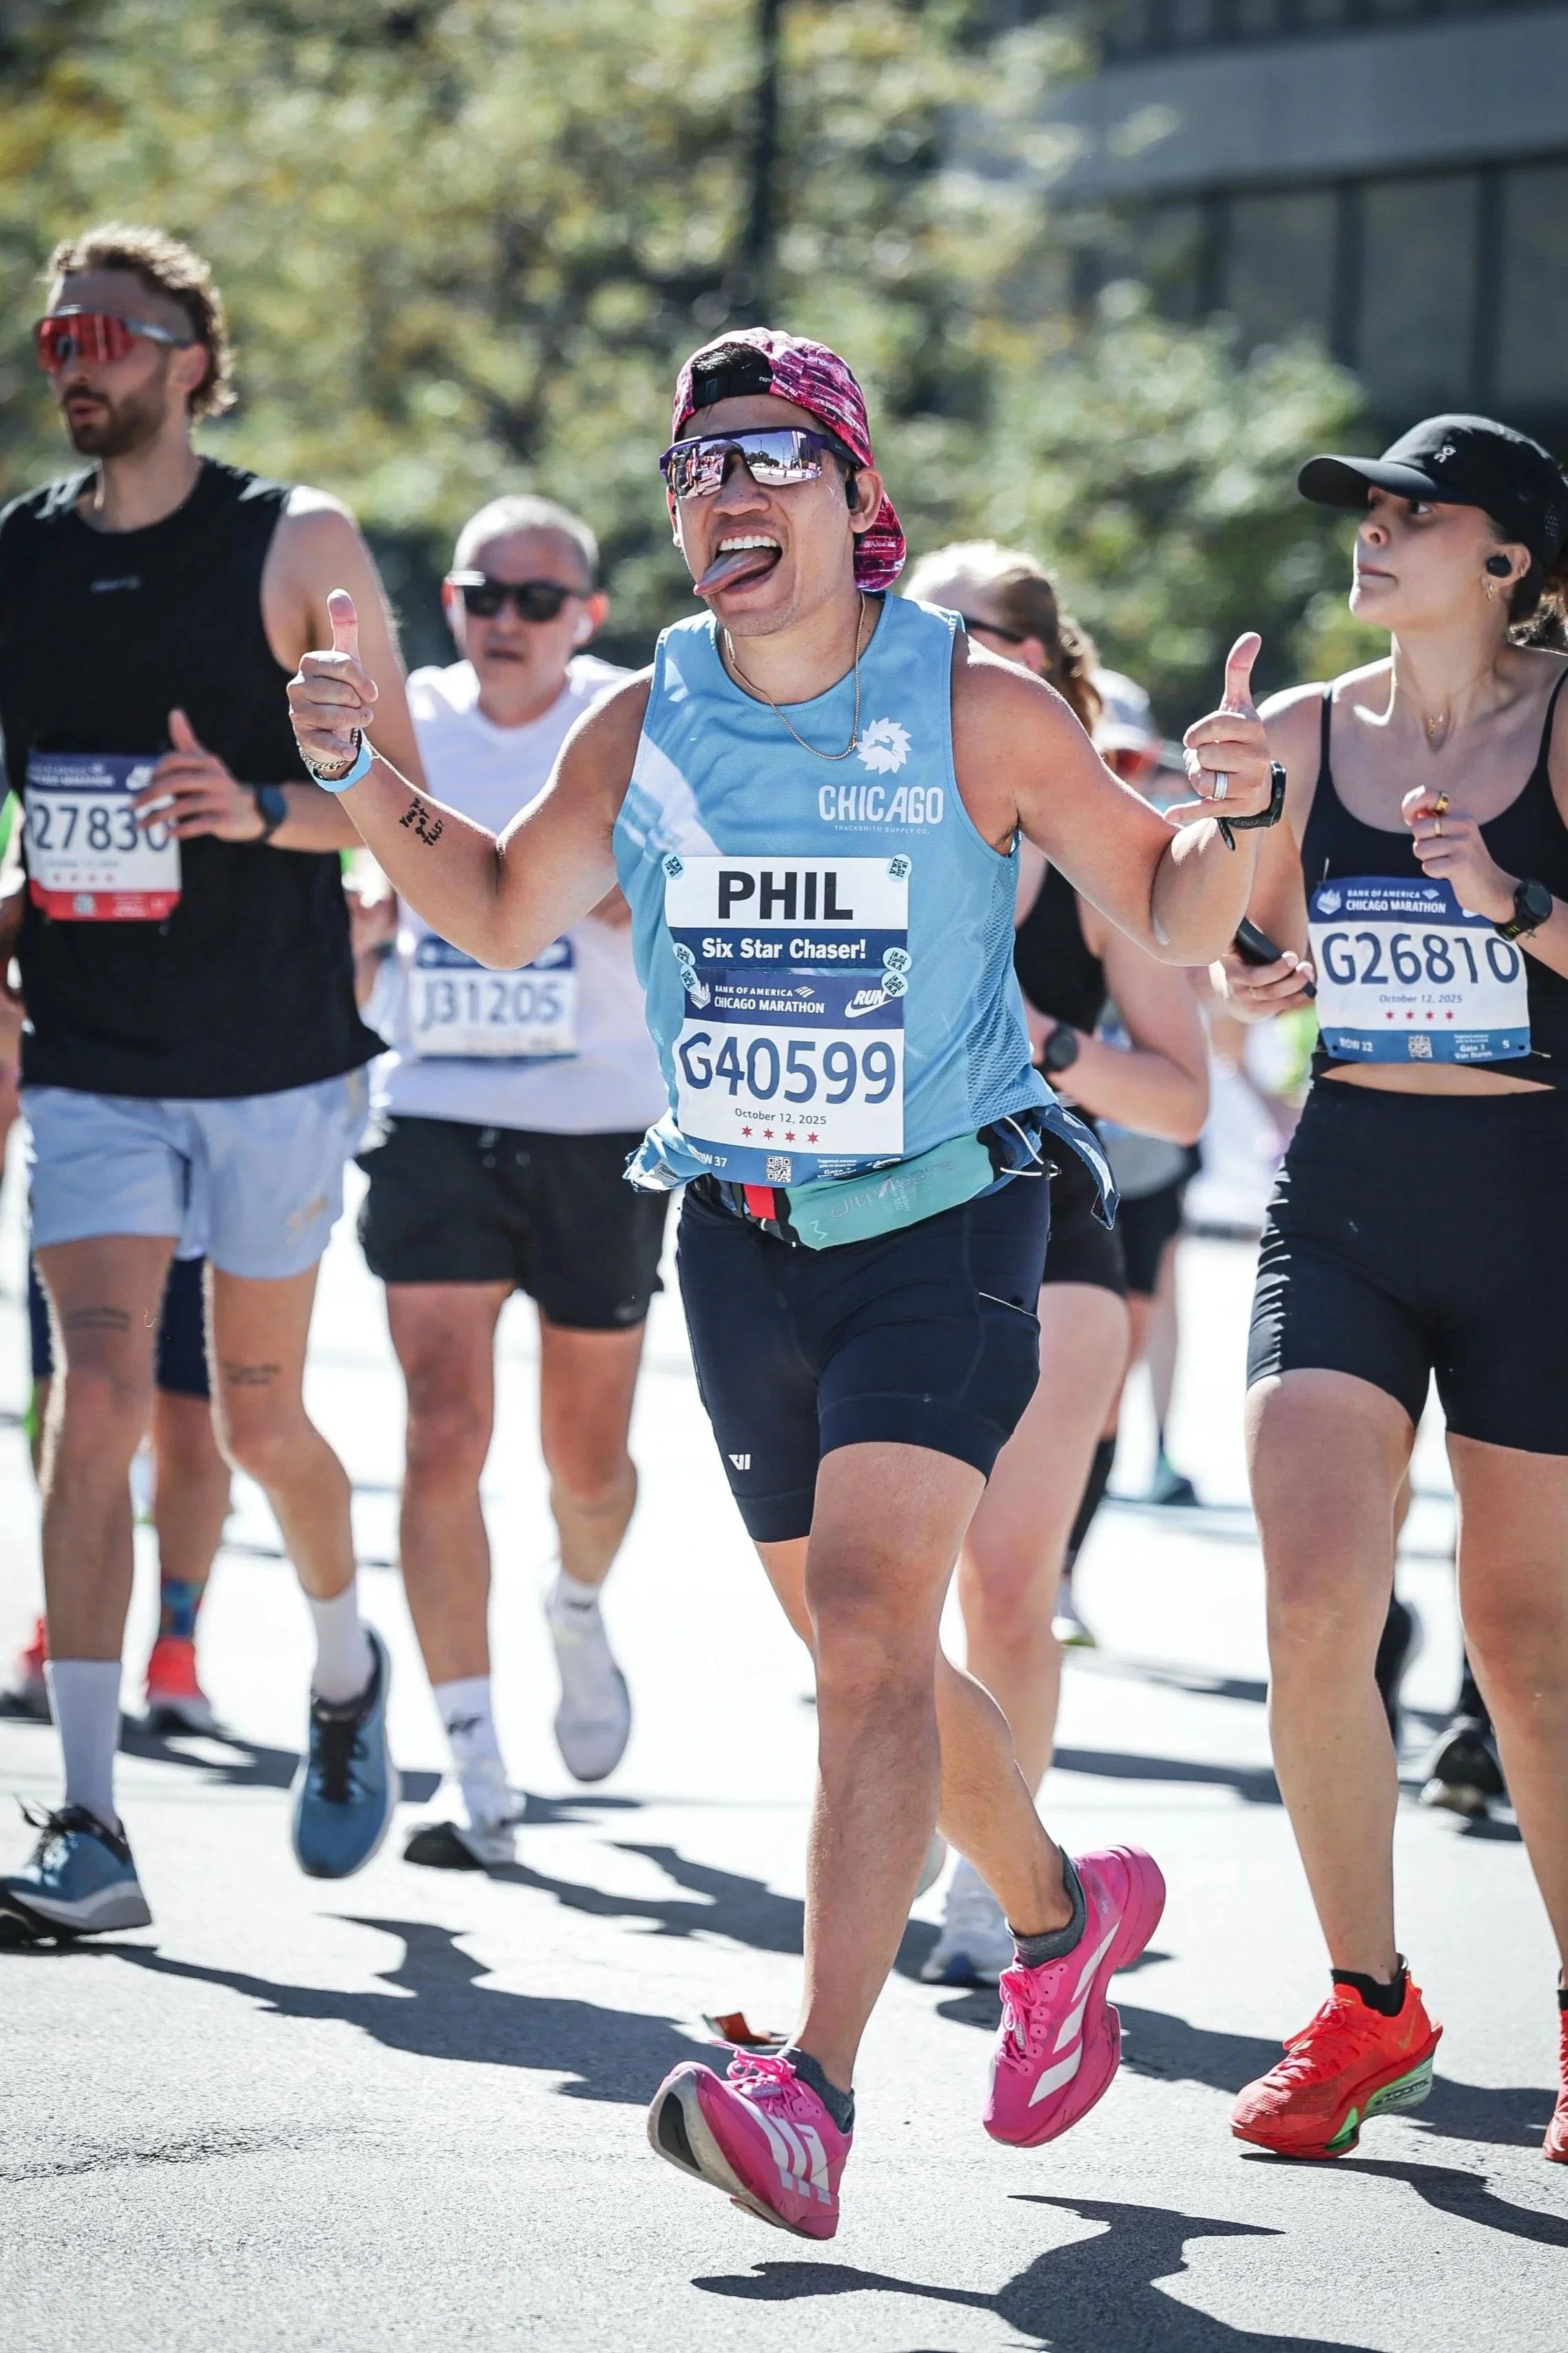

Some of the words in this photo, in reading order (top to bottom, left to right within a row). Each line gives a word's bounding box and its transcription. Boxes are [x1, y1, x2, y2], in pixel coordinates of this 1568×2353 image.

[818, 785, 944, 825] CHICAGO
[718, 871, 854, 920] PHIL
[1371, 890, 1382, 898] OF
[1382, 890, 1421, 898] AMERICA
[1345, 899, 1388, 911] CHICAGO
[1390, 900, 1446, 914] MARATHON
[701, 938, 734, 958] Six
[739, 938, 783, 959] Star
[790, 938, 867, 960] Chaser!
[1321, 932, 1520, 986] G26810
[715, 985, 734, 994] BANK
[750, 987, 793, 997] AMERICA
[854, 989, 887, 1006] RUN
[1379, 994, 1417, 1003] October
[1438, 994, 1463, 1003] 2025
[419, 979, 563, 1032] J31205
[714, 996, 756, 1010] CHICAGO
[759, 999, 825, 1014] MARATHON
[1339, 1037, 1361, 1050] ROW
[1361, 1041, 1374, 1052] 32
[679, 1031, 896, 1104] G40599
[735, 1108, 776, 1121] October
[780, 1113, 795, 1124] 12,
[798, 1115, 827, 1124] 2025
[714, 1156, 728, 1168] 37
